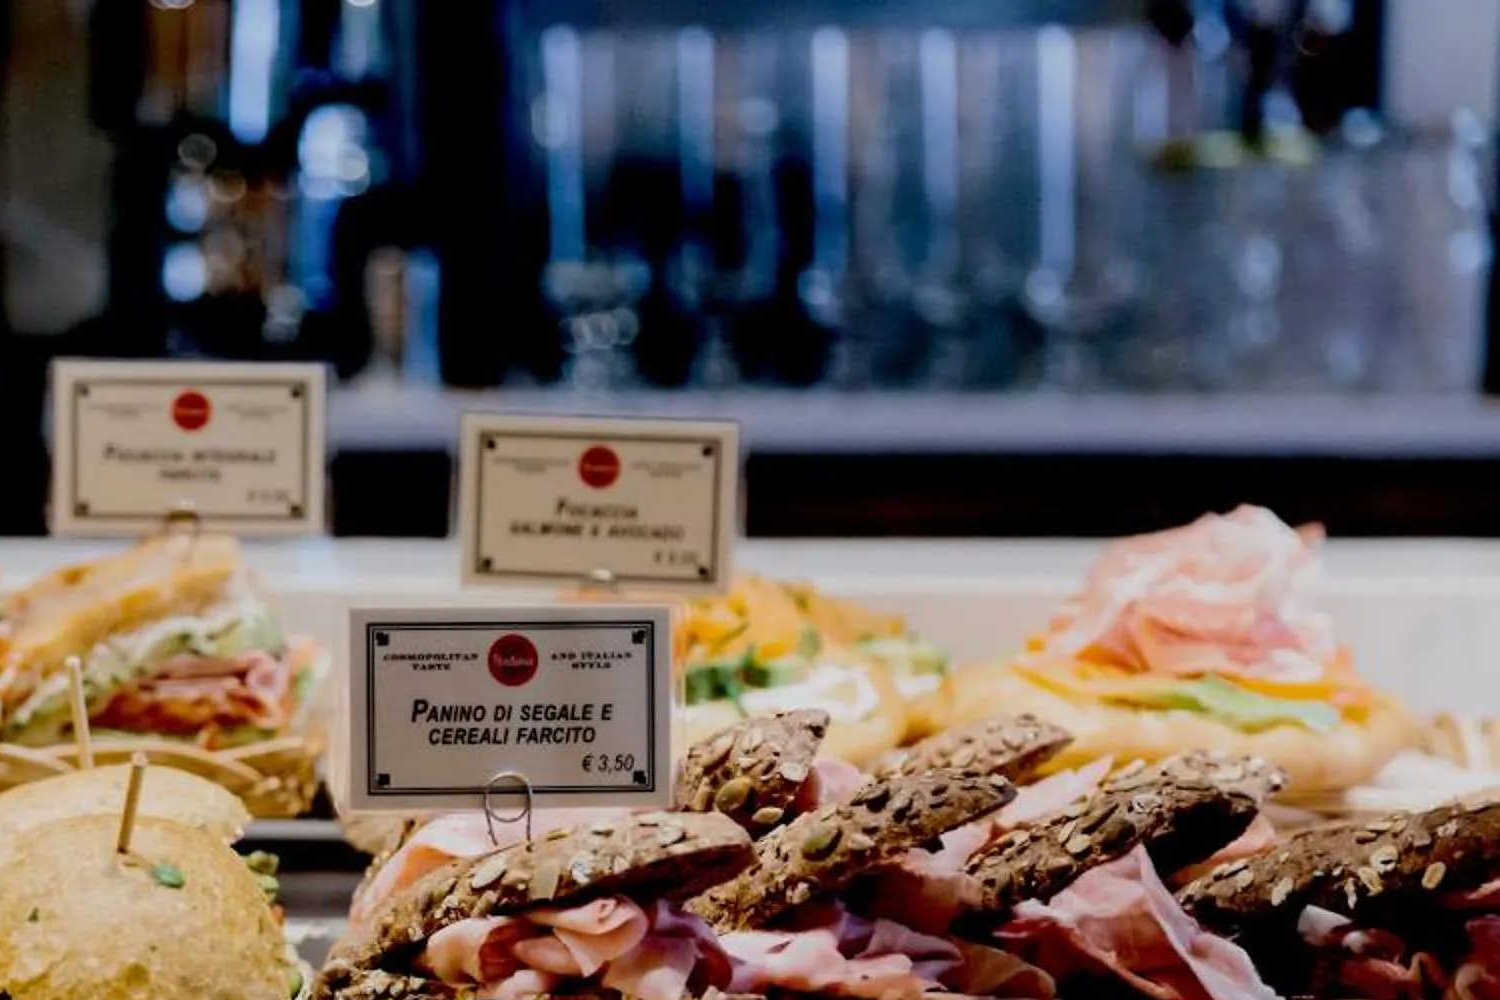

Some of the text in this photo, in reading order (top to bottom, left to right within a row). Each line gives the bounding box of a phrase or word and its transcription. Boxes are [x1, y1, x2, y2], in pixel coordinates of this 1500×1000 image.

[383, 653, 479, 661] COSMOPOLITAN
[581, 652, 633, 660] ITALIAN
[412, 663, 450, 671] TASTE
[411, 700, 613, 723] PANINO DI SEGALE E
[429, 727, 596, 745] CEREALI FARCITO
[582, 754, 635, 775] € 3,50
